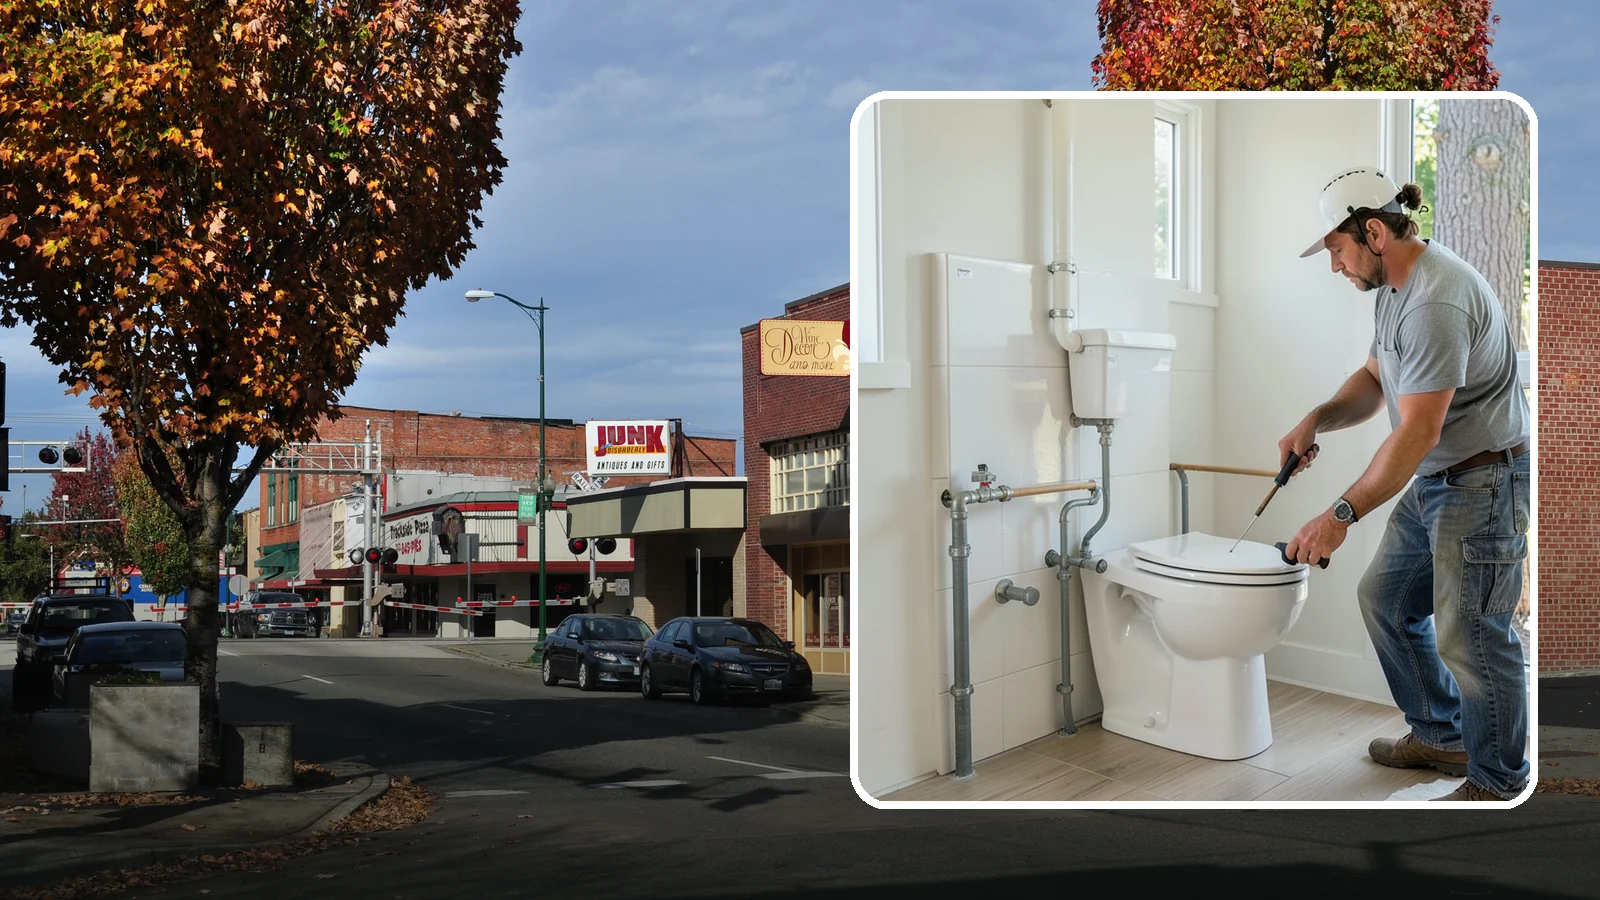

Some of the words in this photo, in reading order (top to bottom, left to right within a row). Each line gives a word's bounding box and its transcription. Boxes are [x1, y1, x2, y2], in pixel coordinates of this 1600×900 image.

[595, 425, 666, 457] JUNK
[597, 461, 628, 470] ANTIQUES
[631, 461, 644, 470] AND
[647, 460, 665, 469] GIFTS
[390, 521, 413, 539] Trackside
[414, 519, 429, 535] Pizza
